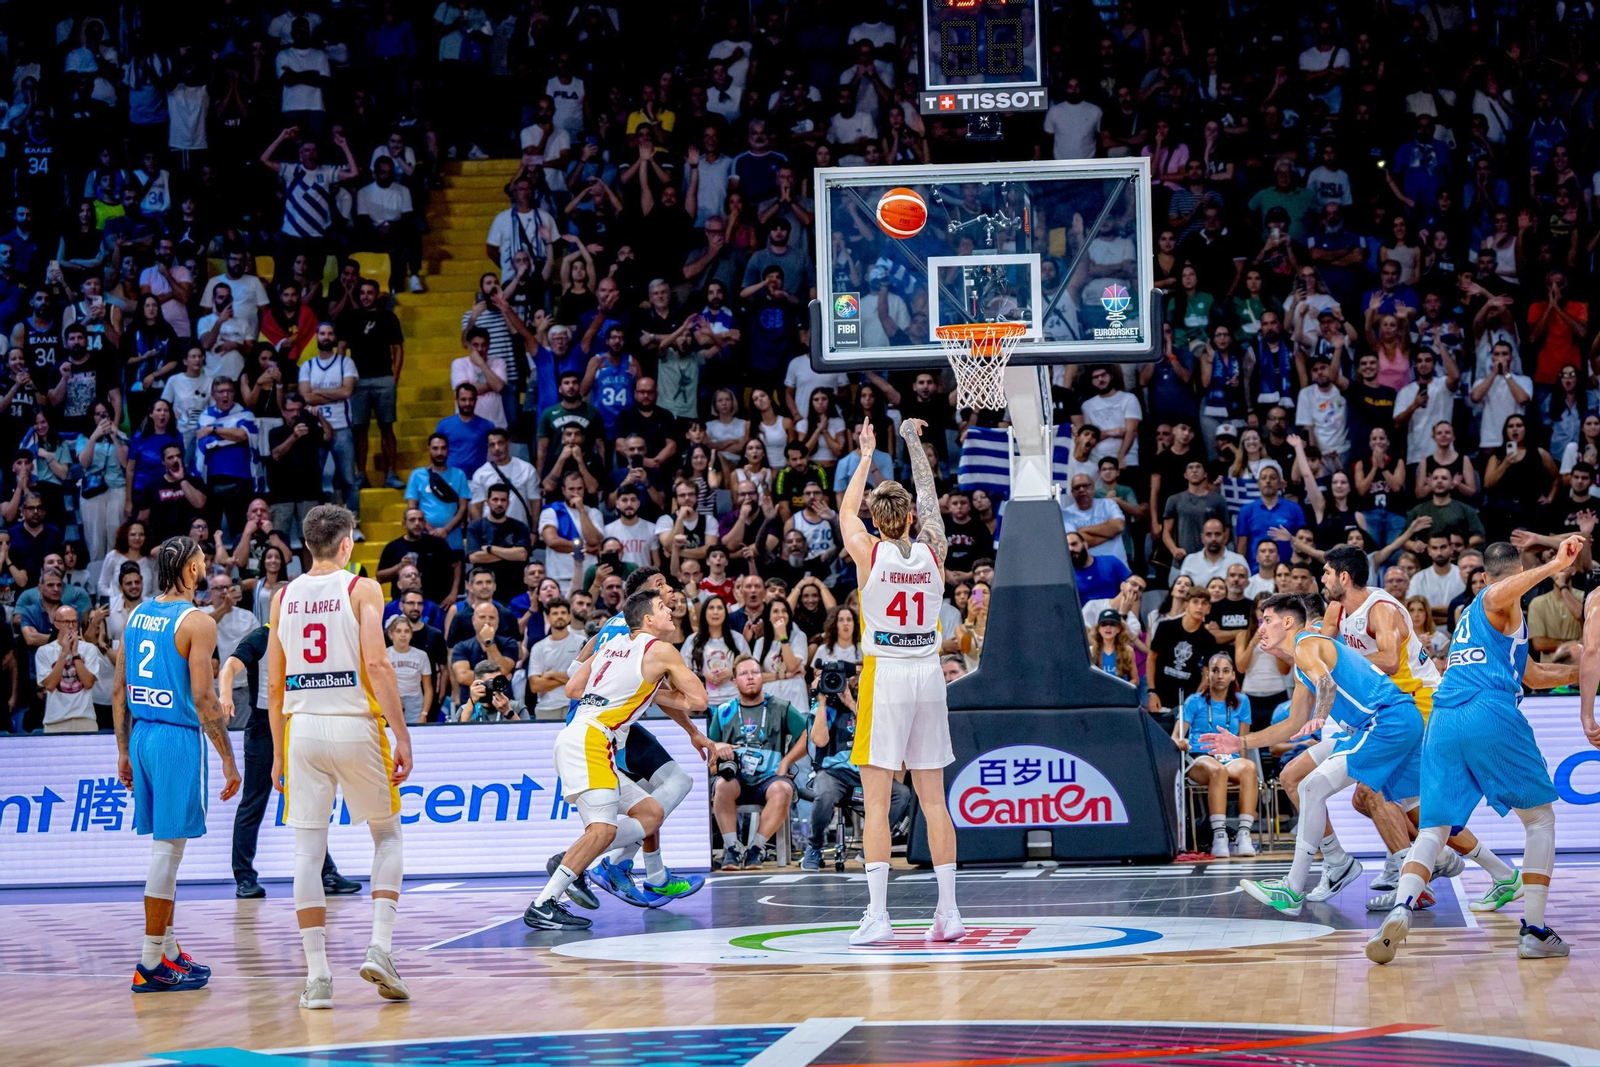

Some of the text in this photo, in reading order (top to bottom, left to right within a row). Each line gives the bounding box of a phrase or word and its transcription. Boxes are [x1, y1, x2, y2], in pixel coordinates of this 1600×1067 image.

[554, 91, 579, 100] FILA
[957, 91, 1045, 110] TISSOT
[28, 157, 49, 175] 34
[837, 324, 858, 334] FIBA
[1094, 327, 1139, 338] EUROBASKET
[34, 347, 55, 367] 34
[602, 387, 627, 406] 34
[880, 571, 887, 583] J.
[288, 599, 341, 614] DE LARREA
[886, 591, 924, 626] 41
[303, 623, 326, 663] 3
[889, 633, 936, 648] CaixaBank
[138, 639, 157, 679] 2
[1449, 648, 1486, 666] EKO
[299, 675, 354, 689] CaixaBank
[133, 687, 172, 706] EKO
[979, 758, 1077, 787] 百岁山
